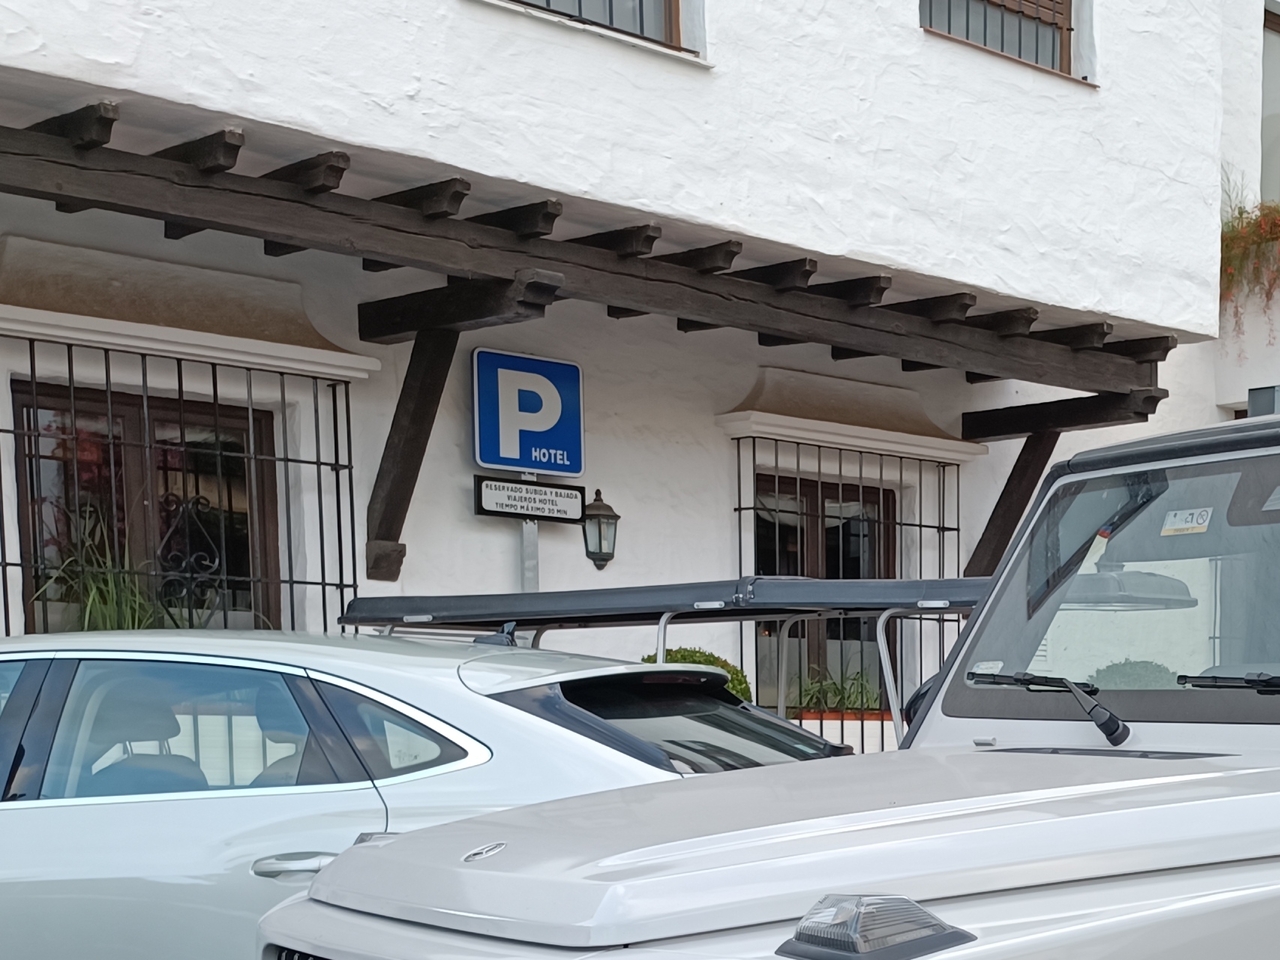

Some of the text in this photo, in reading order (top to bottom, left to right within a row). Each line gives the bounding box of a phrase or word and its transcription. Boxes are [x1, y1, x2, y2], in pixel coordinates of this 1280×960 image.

[497, 368, 562, 459] P
[532, 447, 570, 465] HOTEL
[485, 483, 523, 494] RESERVADO
[525, 487, 548, 496] SUBIDA
[554, 491, 578, 499] BAJADA
[495, 502, 519, 511] TIEMPO
[520, 503, 546, 513] MÁXIMO
[507, 494, 558, 507] VIAJEROS HOTEL
